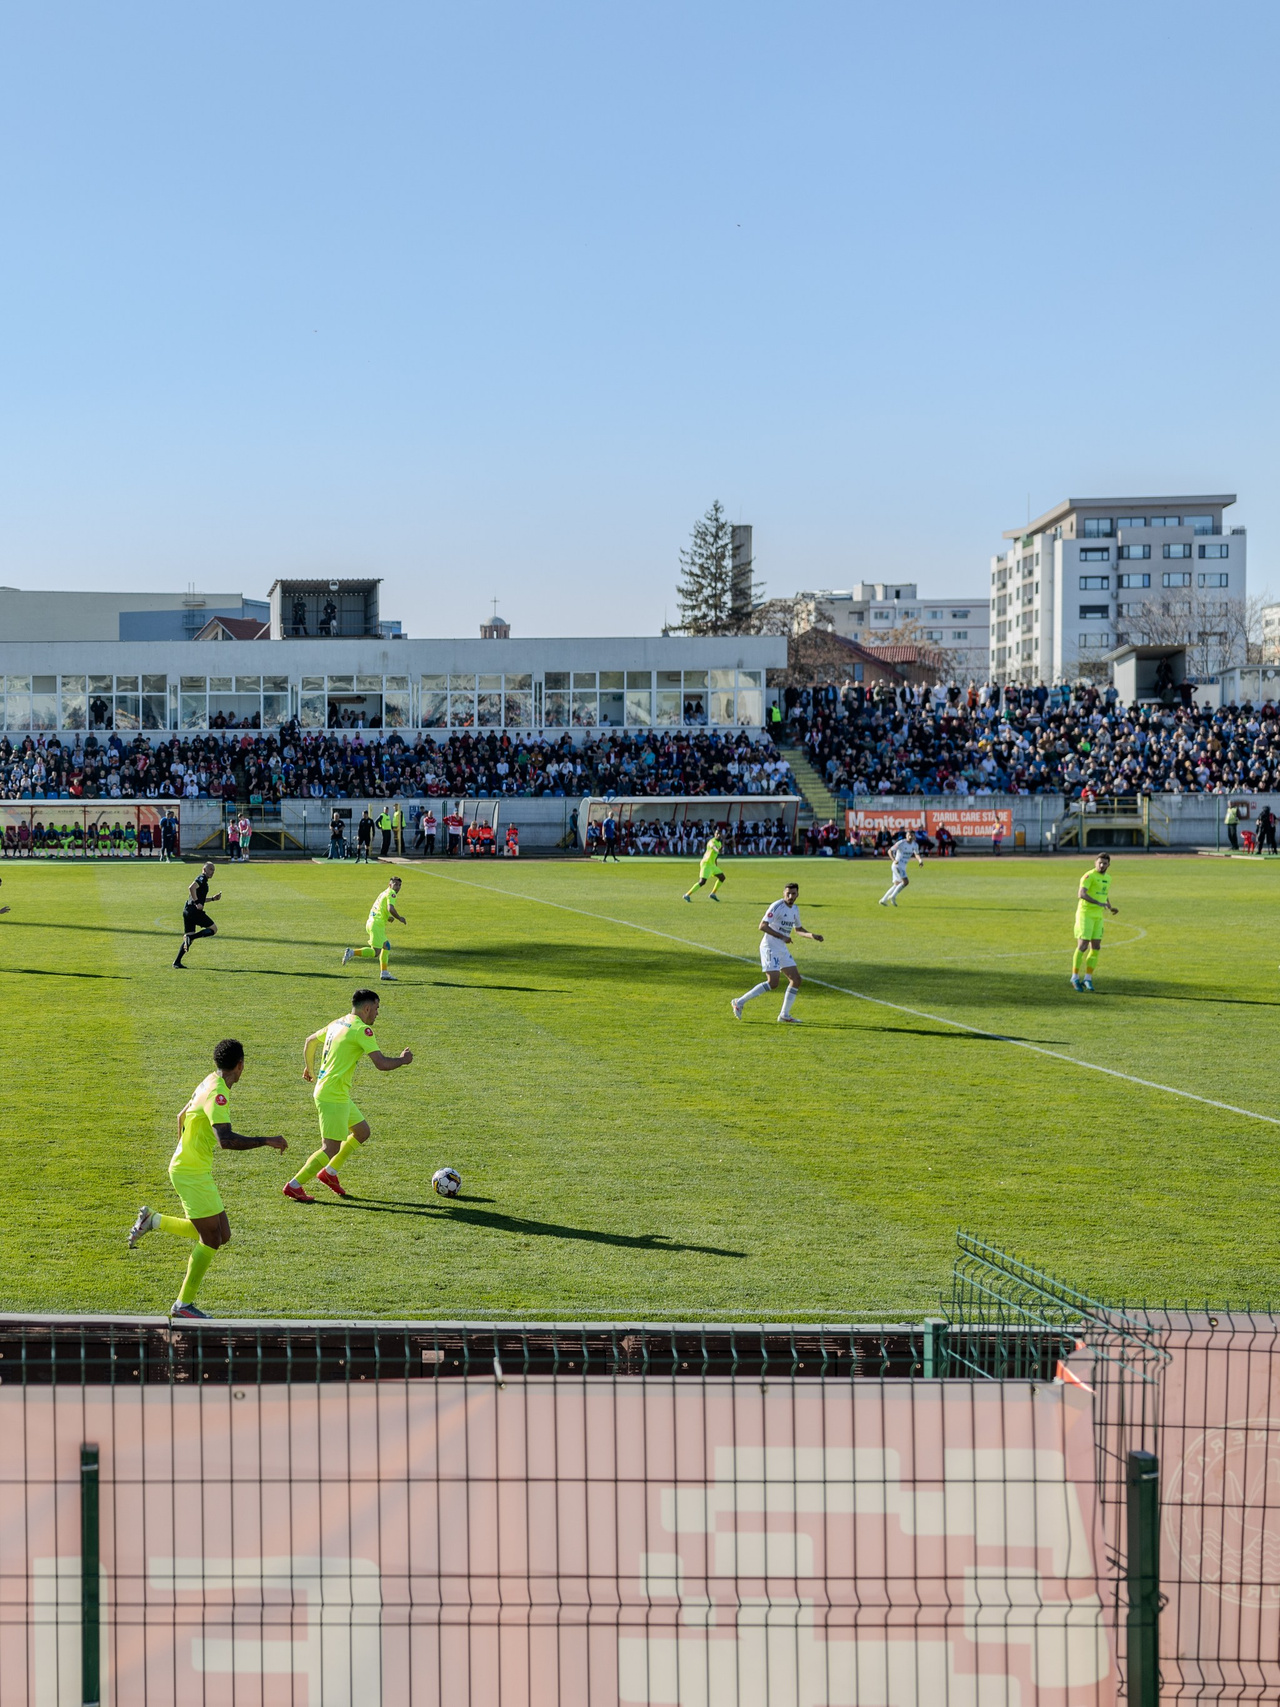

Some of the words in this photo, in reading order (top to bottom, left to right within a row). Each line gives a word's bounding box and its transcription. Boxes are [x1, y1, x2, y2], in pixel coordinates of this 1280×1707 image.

[848, 811, 926, 828] Monitorul
[932, 811, 959, 822] ZIARUL
[960, 811, 980, 822] CARE
[963, 825, 973, 836] CU
